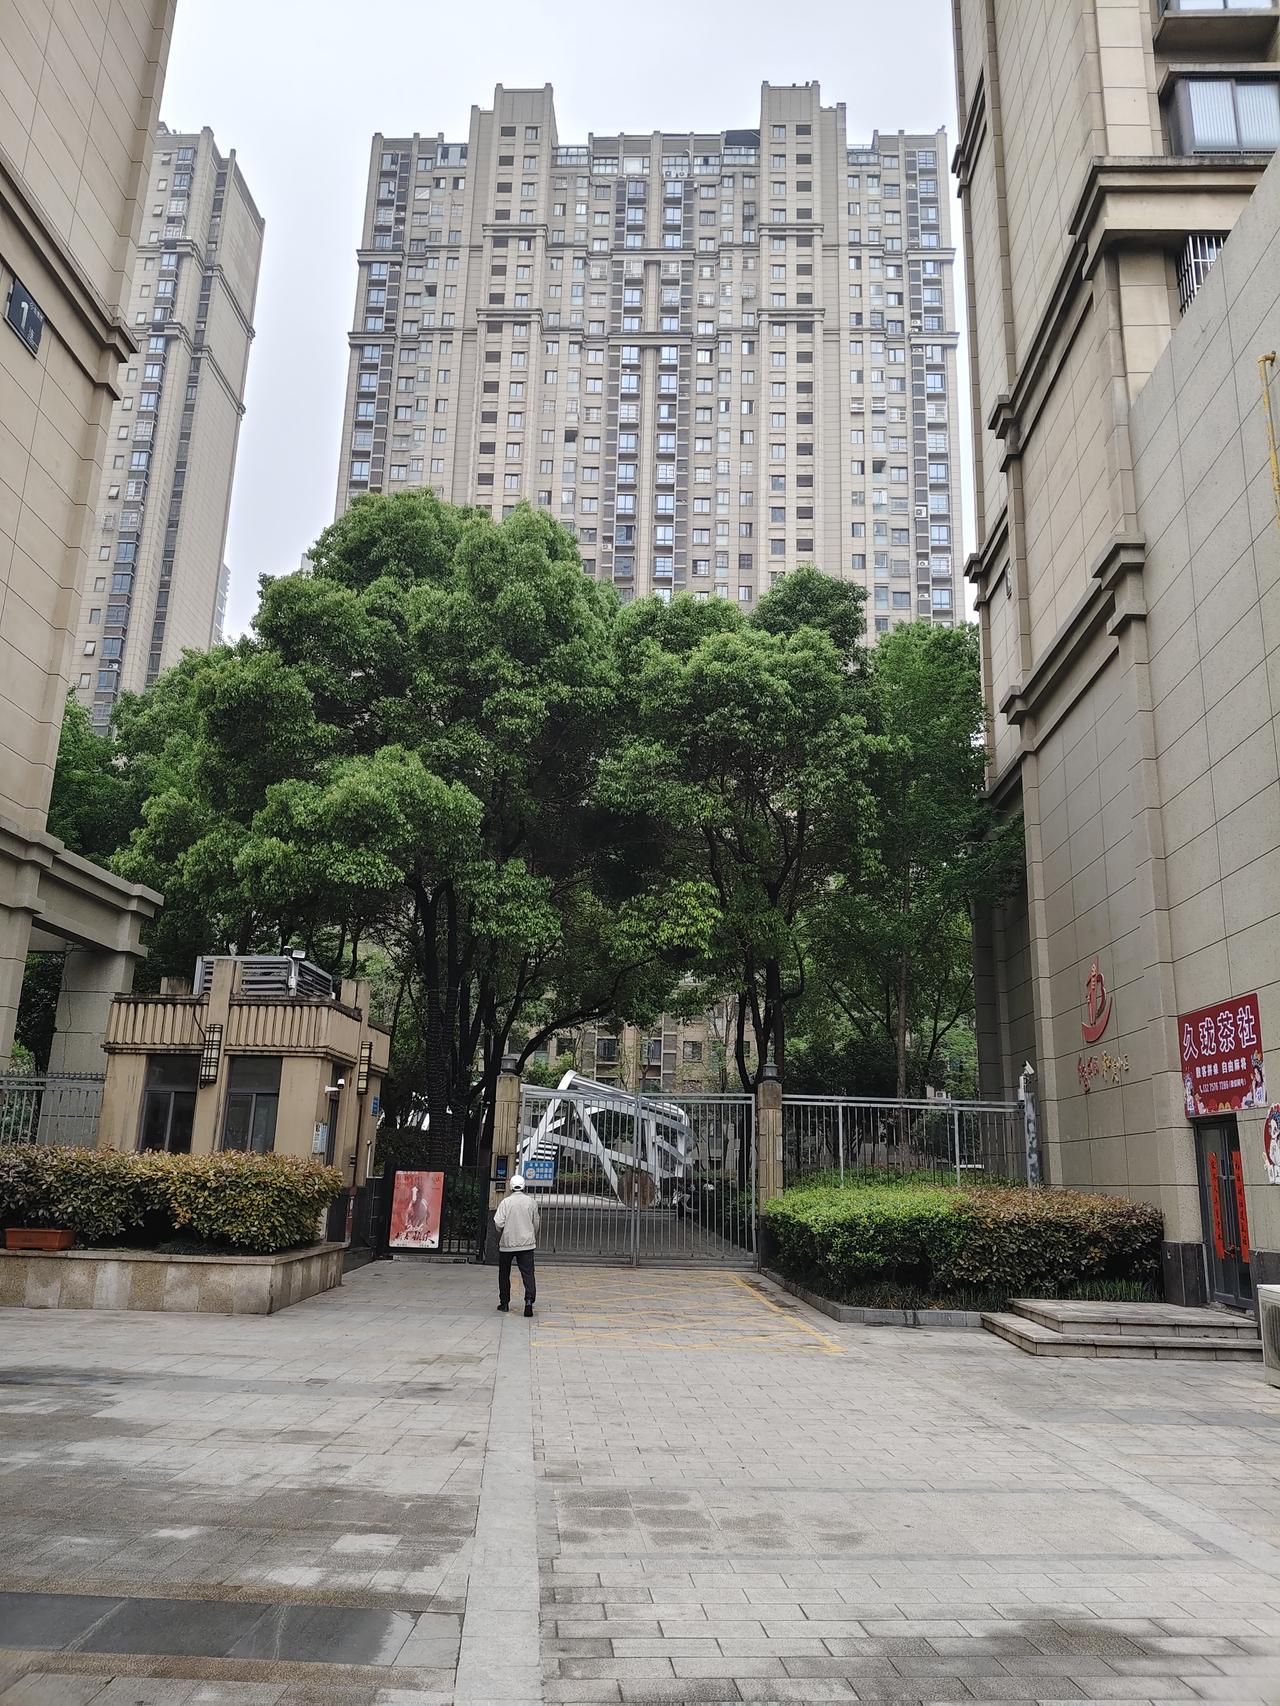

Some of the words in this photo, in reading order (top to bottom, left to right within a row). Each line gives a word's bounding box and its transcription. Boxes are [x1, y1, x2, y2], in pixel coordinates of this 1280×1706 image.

[20, 301, 29, 330] 1
[1183, 1005, 1256, 1061] 久珑茶社
